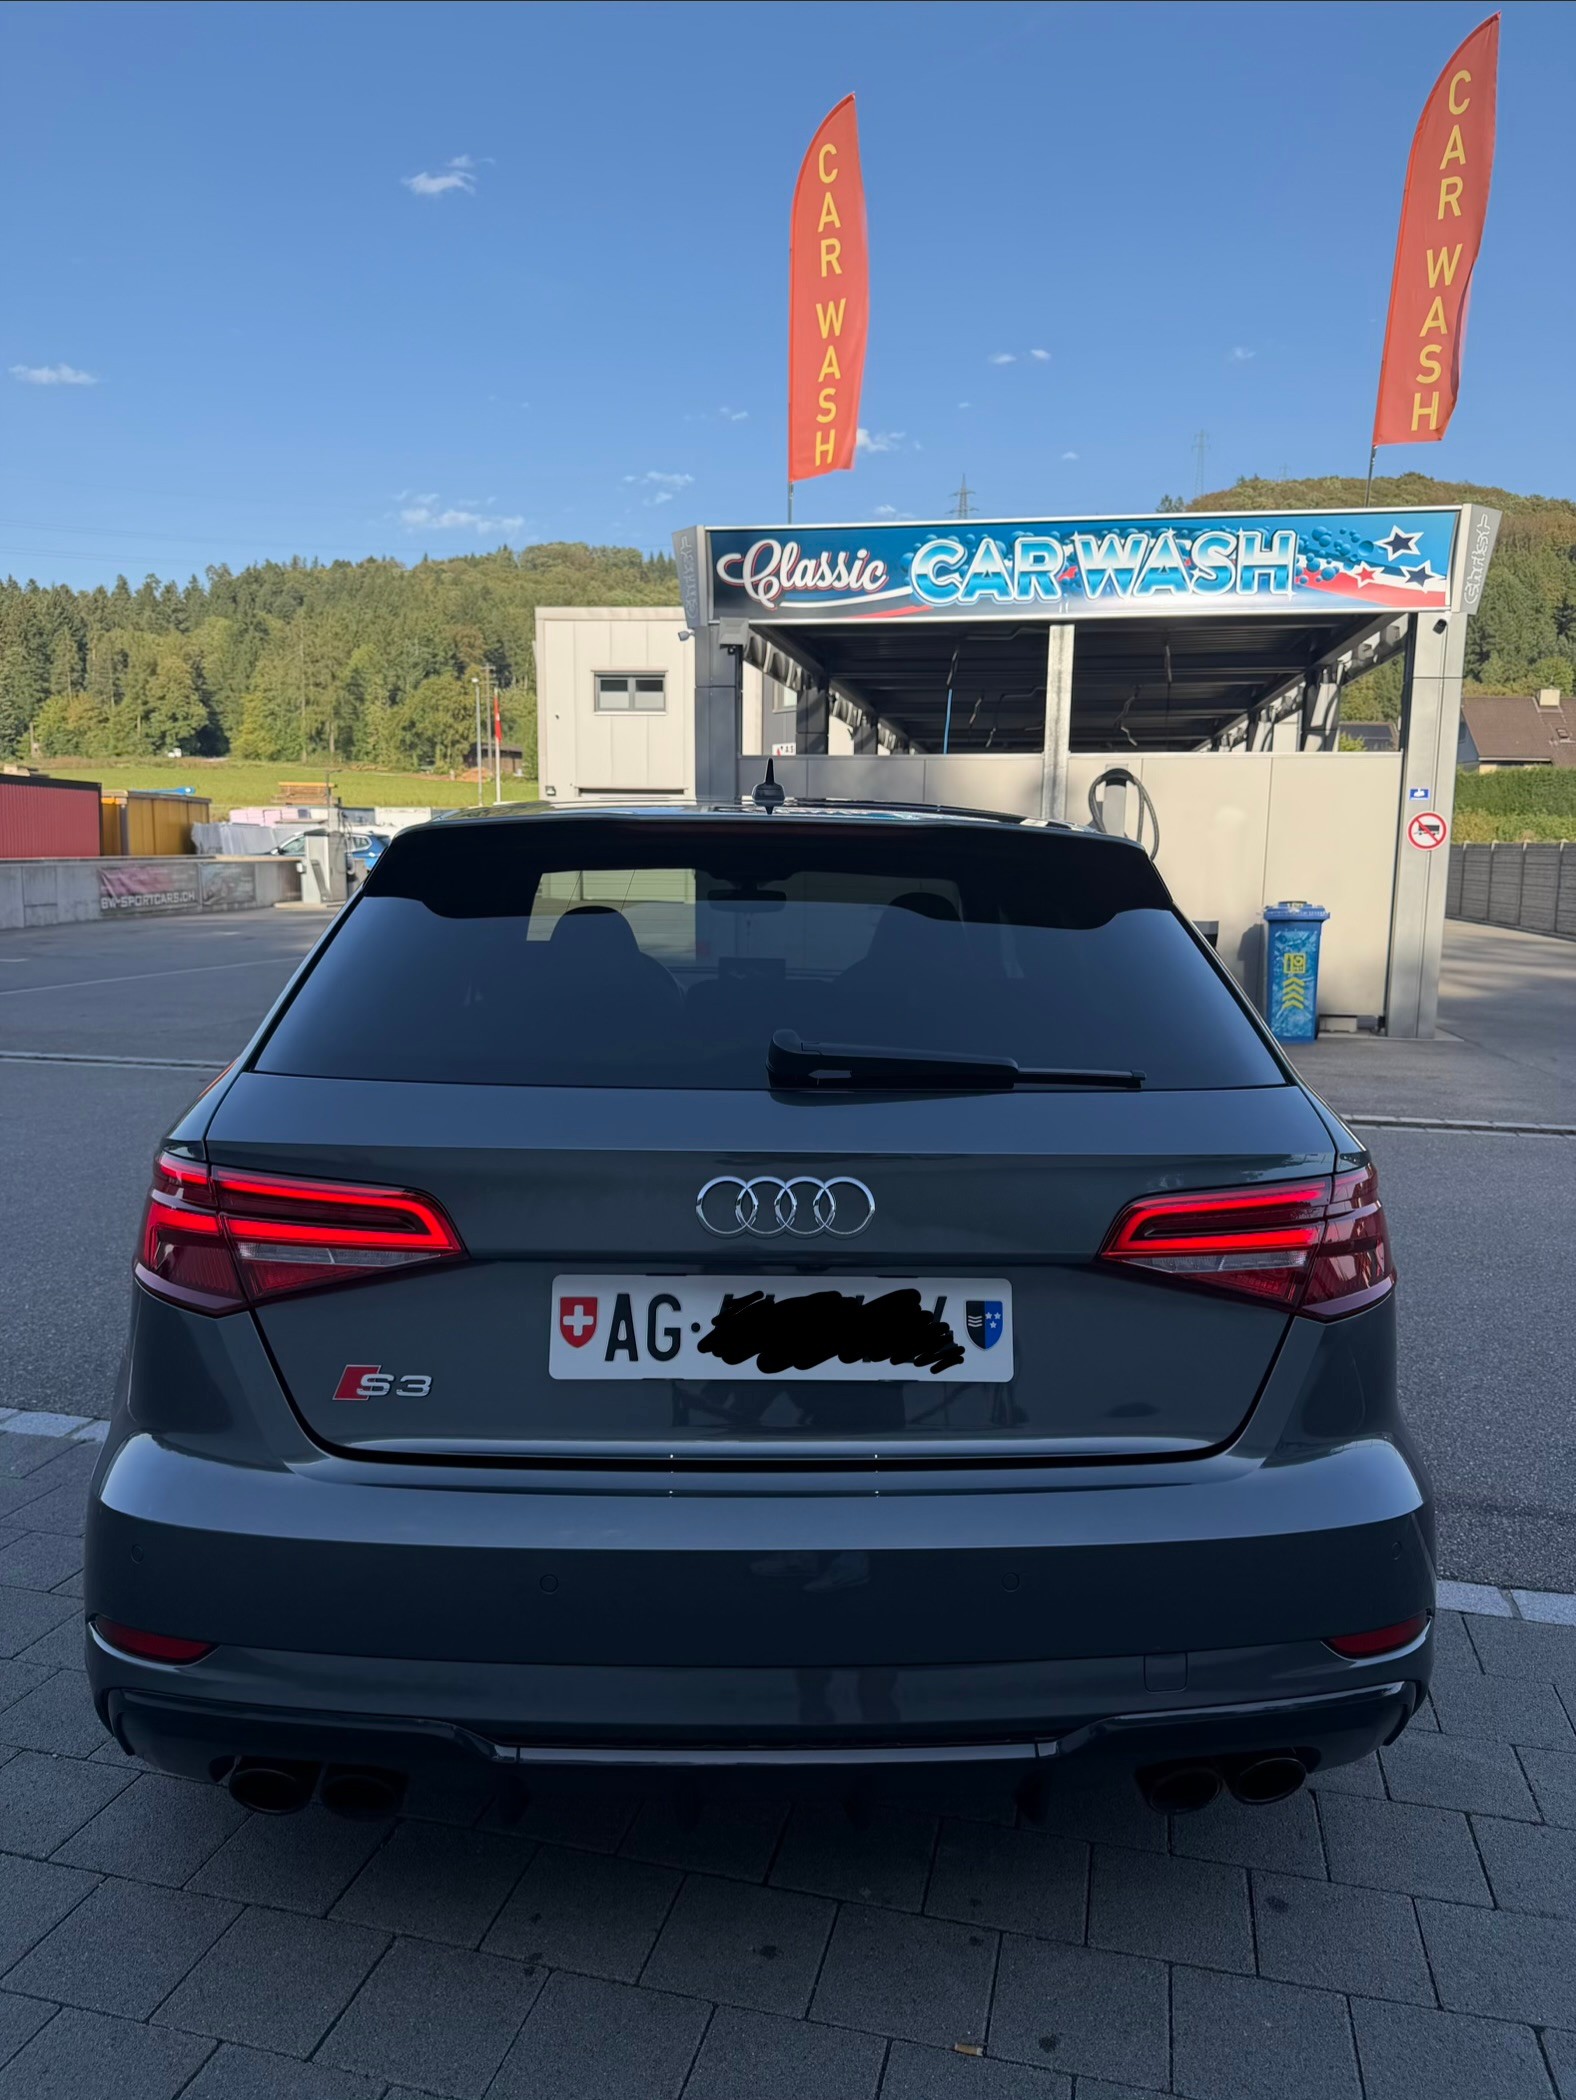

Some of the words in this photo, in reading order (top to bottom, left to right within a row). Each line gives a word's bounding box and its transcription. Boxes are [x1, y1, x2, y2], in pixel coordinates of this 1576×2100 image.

[817, 142, 843, 278] CAR
[1437, 69, 1472, 221] CAR
[815, 297, 847, 467] WASH
[1410, 243, 1463, 432] WASH
[716, 538, 890, 611] Classic
[909, 536, 1066, 605] CAR
[1073, 528, 1298, 601] WASH
[356, 1373, 433, 1397] S3
